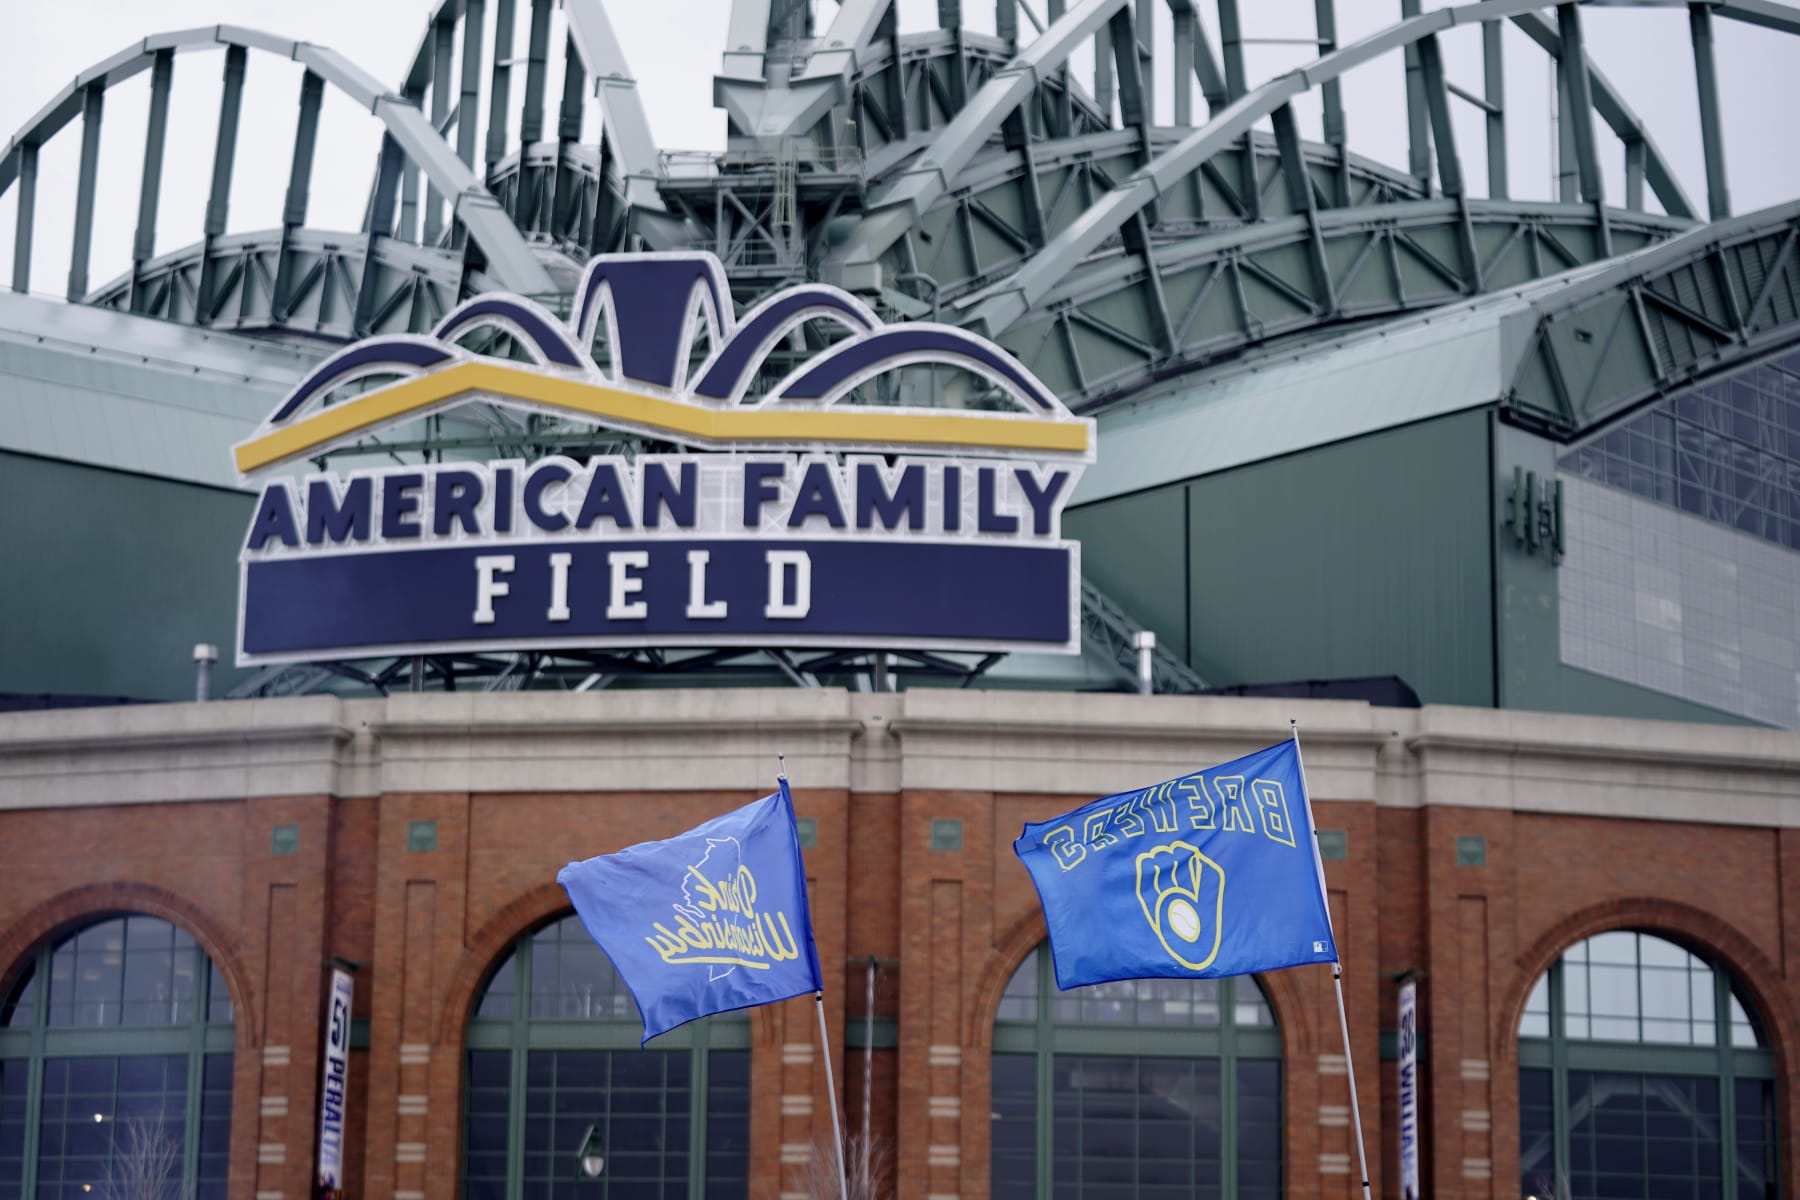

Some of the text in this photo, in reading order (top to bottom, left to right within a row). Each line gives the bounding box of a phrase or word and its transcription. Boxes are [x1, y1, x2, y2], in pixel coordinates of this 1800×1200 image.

[248, 460, 1071, 550] AMERICAN FAMILY
[473, 549, 812, 624] FIELD
[331, 997, 348, 1054] 51
[321, 1056, 346, 1167] PERALTA
